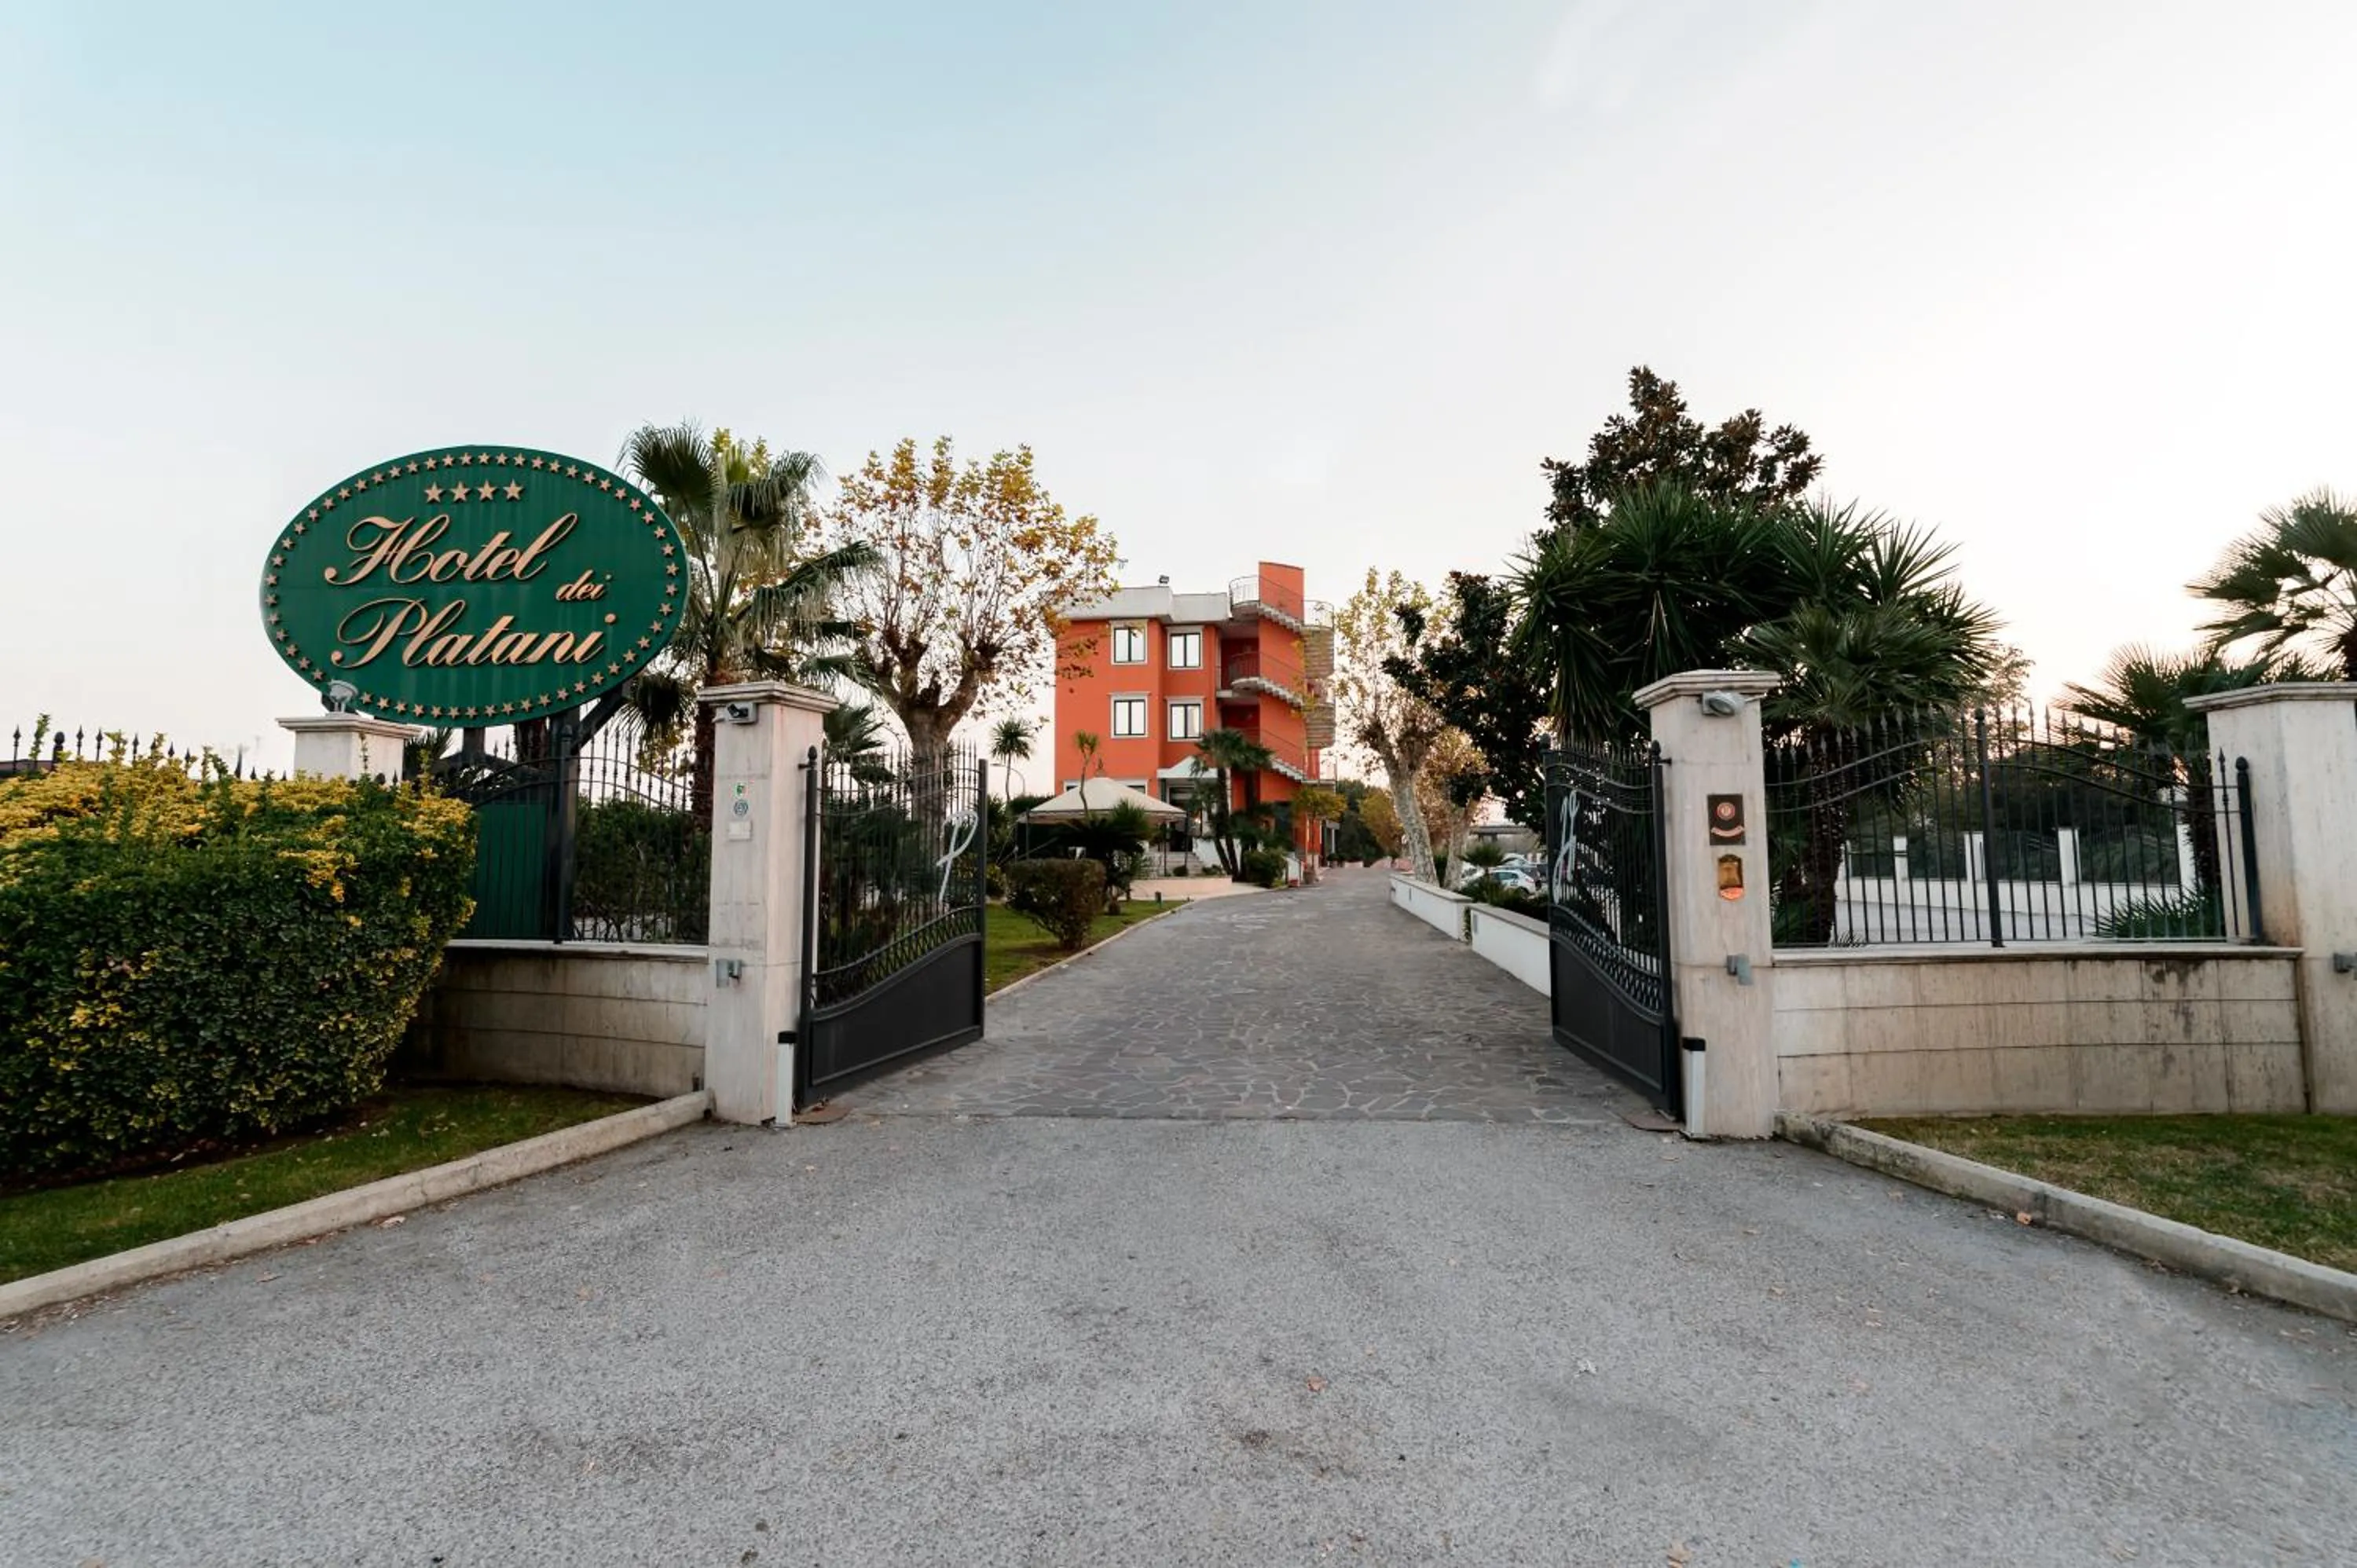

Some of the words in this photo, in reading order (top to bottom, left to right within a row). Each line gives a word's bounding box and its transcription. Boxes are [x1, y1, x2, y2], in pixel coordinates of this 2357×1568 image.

[324, 512, 577, 585] Hotel
[555, 569, 612, 601] dei
[331, 597, 616, 668] Platani
